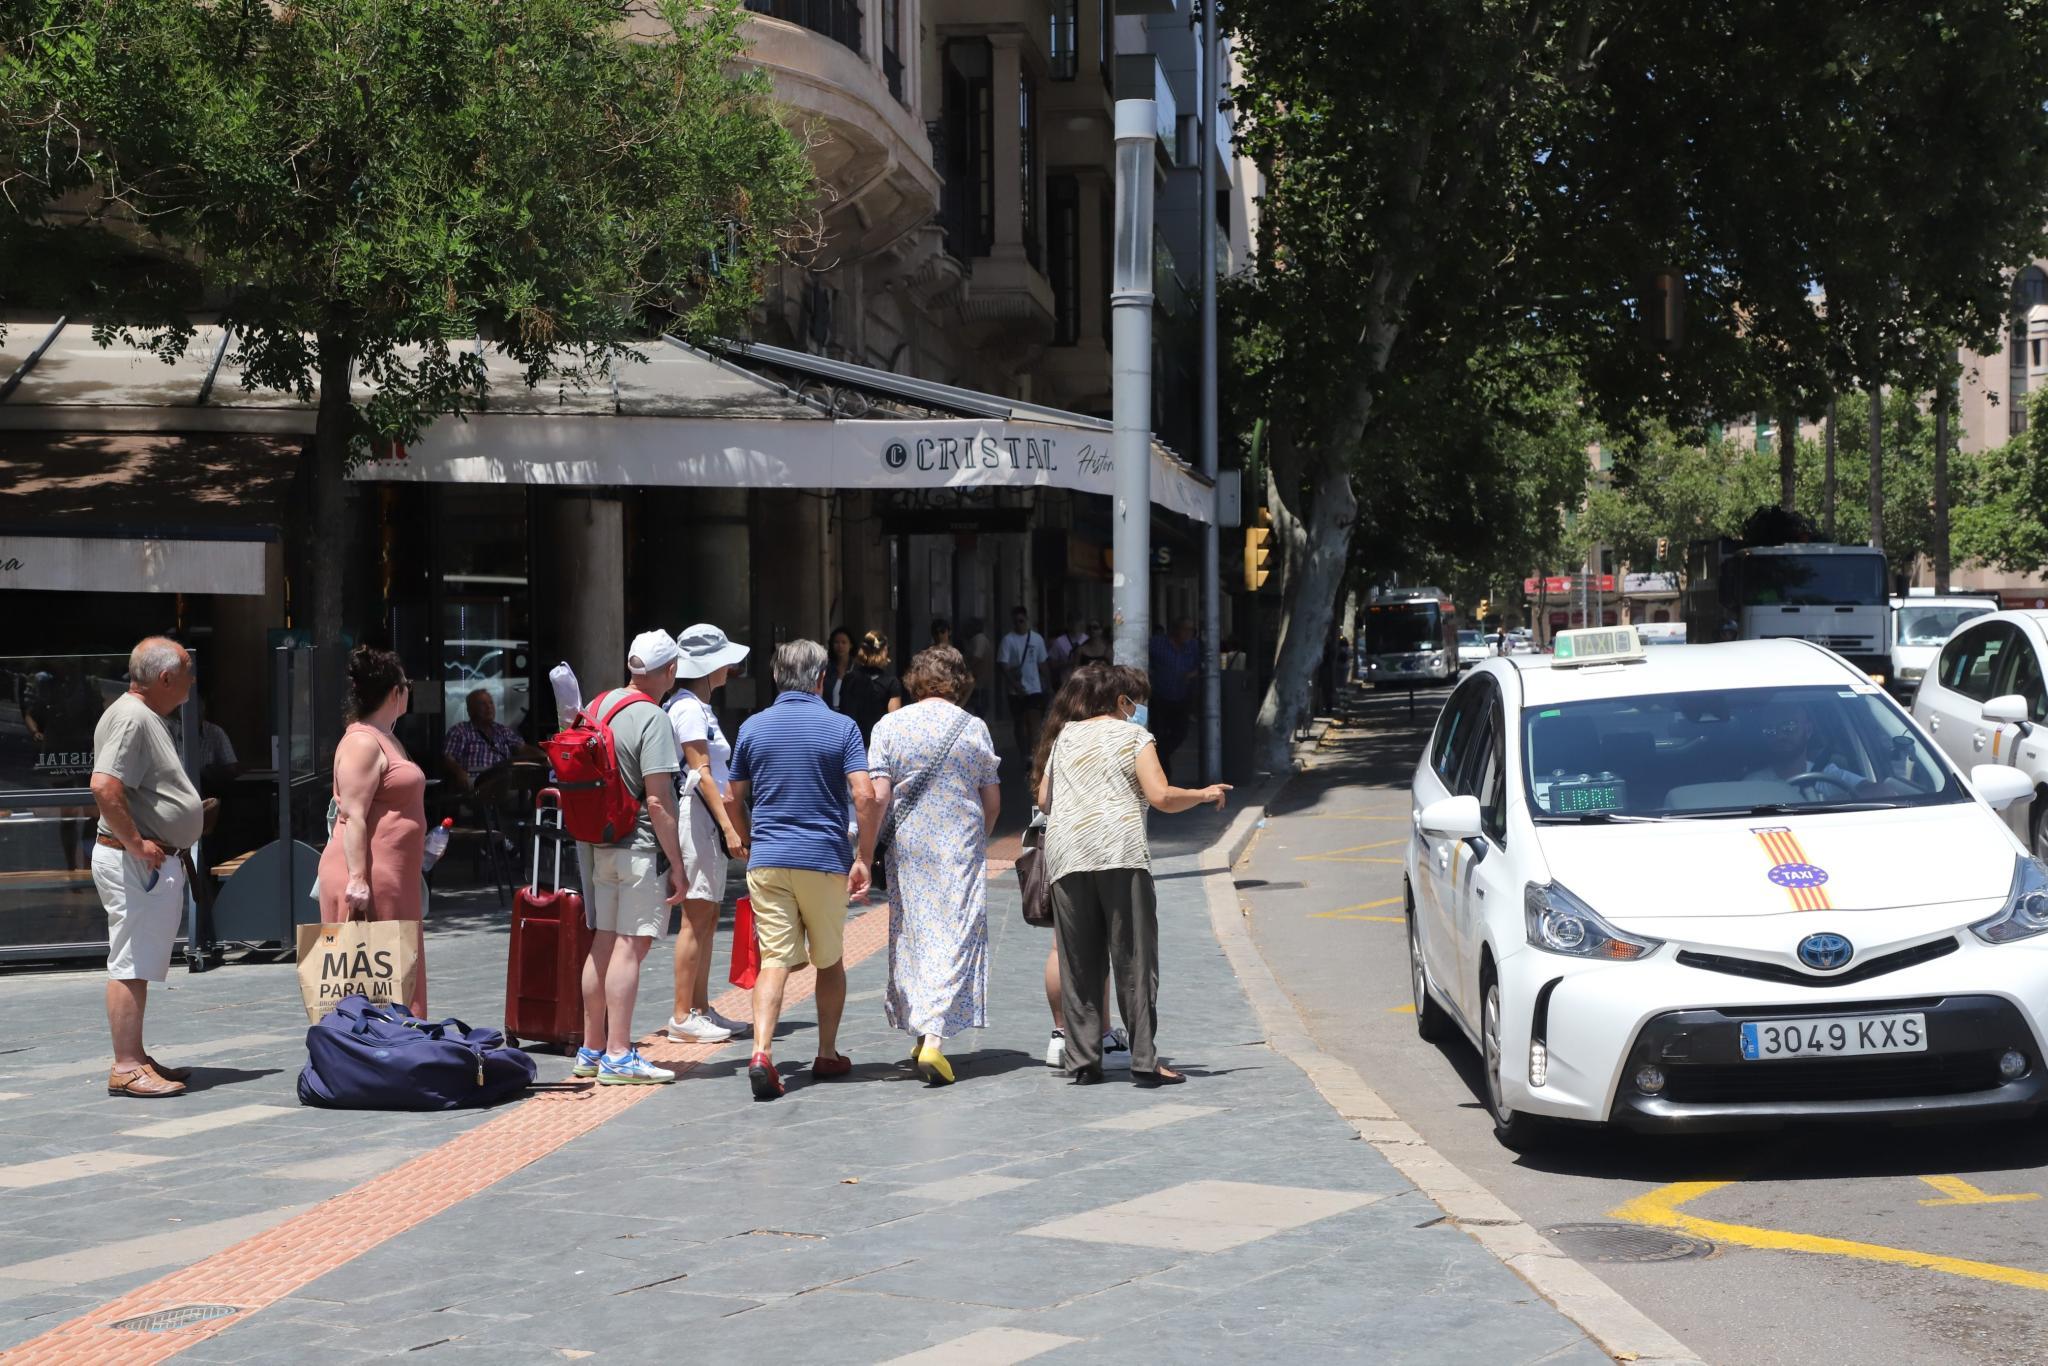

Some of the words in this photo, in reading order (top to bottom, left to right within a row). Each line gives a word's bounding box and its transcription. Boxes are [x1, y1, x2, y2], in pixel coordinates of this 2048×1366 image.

[917, 437, 1058, 472] CRISTAL
[1576, 632, 1615, 657] TAXI
[1560, 787, 1616, 811] LIBRE
[1781, 871, 1814, 880] TAXI
[326, 935, 335, 943] M
[322, 942, 393, 980] MÁS
[320, 982, 367, 998] PARA
[373, 977, 393, 997] MÍ
[1764, 1023, 1847, 1054] 3049
[1858, 1018, 1920, 1049] KXS
